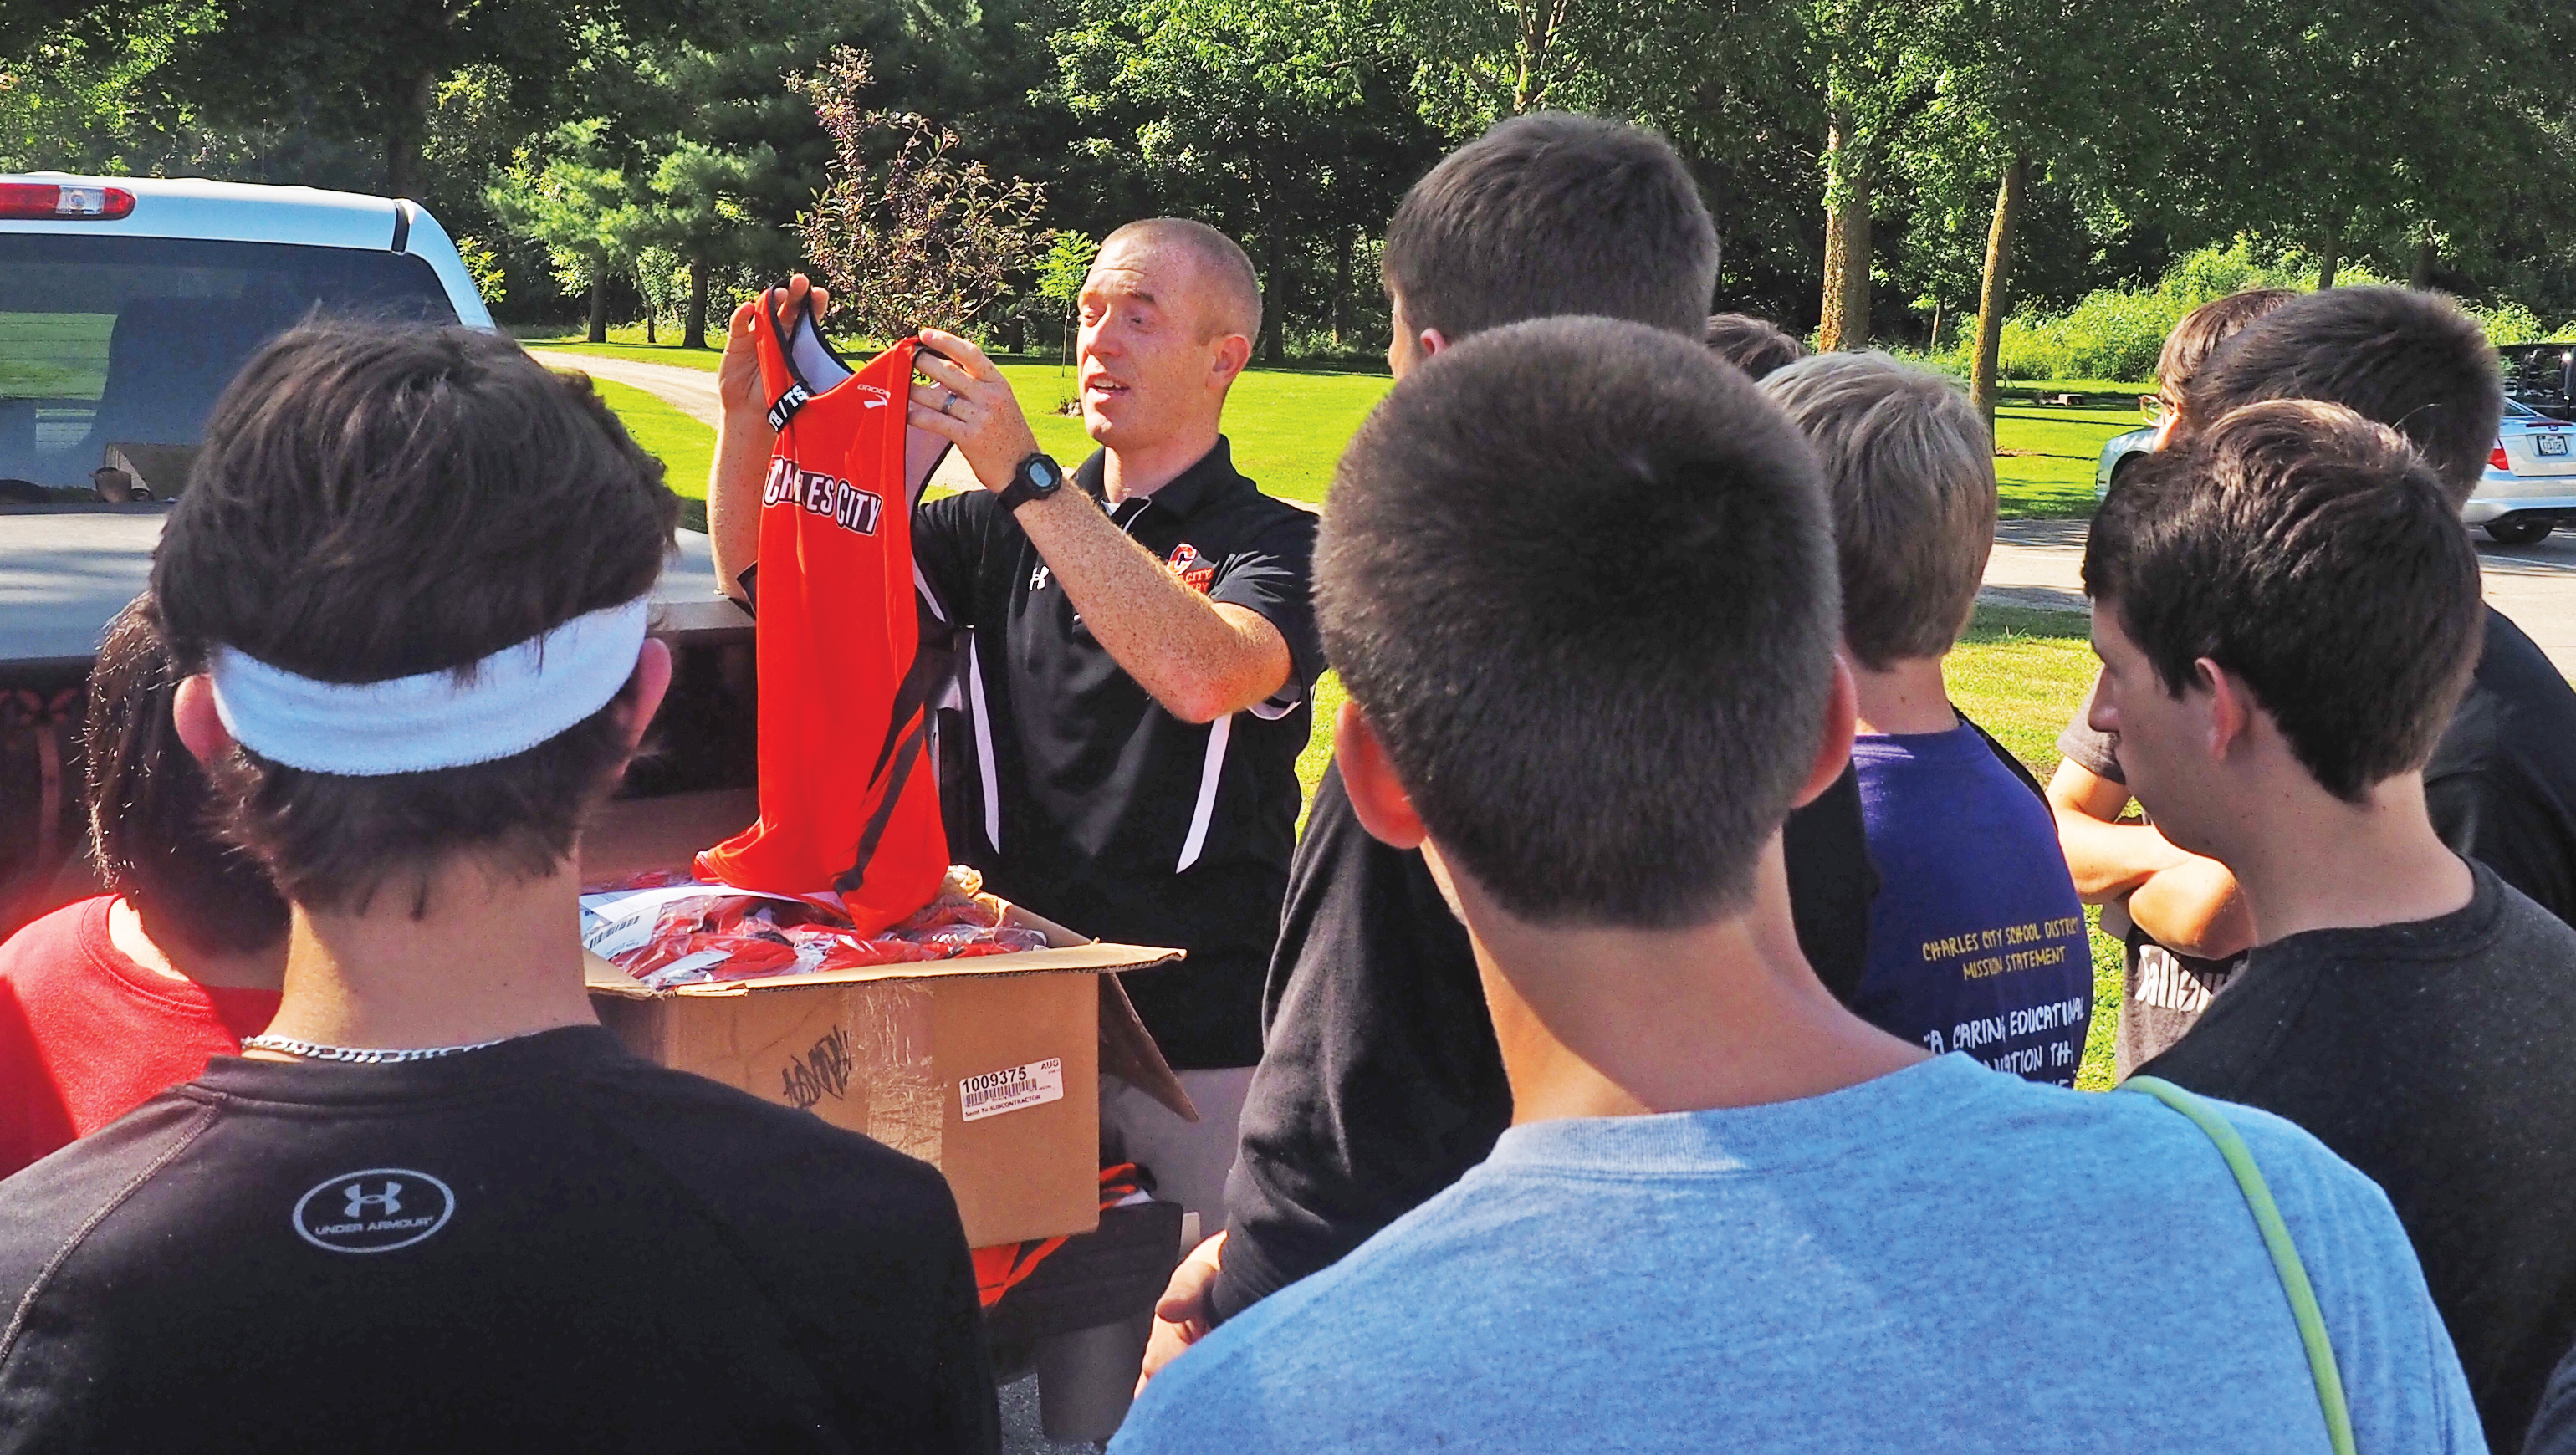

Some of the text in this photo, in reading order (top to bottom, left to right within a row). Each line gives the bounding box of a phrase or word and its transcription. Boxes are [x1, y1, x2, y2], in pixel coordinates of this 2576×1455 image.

[783, 385, 808, 407] TS
[836, 482, 882, 533] CITY
[1186, 569, 1212, 581] CITY
[1922, 932, 1980, 961] CHARLES
[1982, 928, 2002, 949] CITY
[2006, 923, 2041, 945] SCHOOL
[2006, 946, 2066, 972] STATEMENT
[962, 1059, 1059, 1093] 1009375 AUG
[989, 1095, 1040, 1111] SUBCONTRACTOR
[315, 1218, 430, 1236] UNDER ARMOUR
